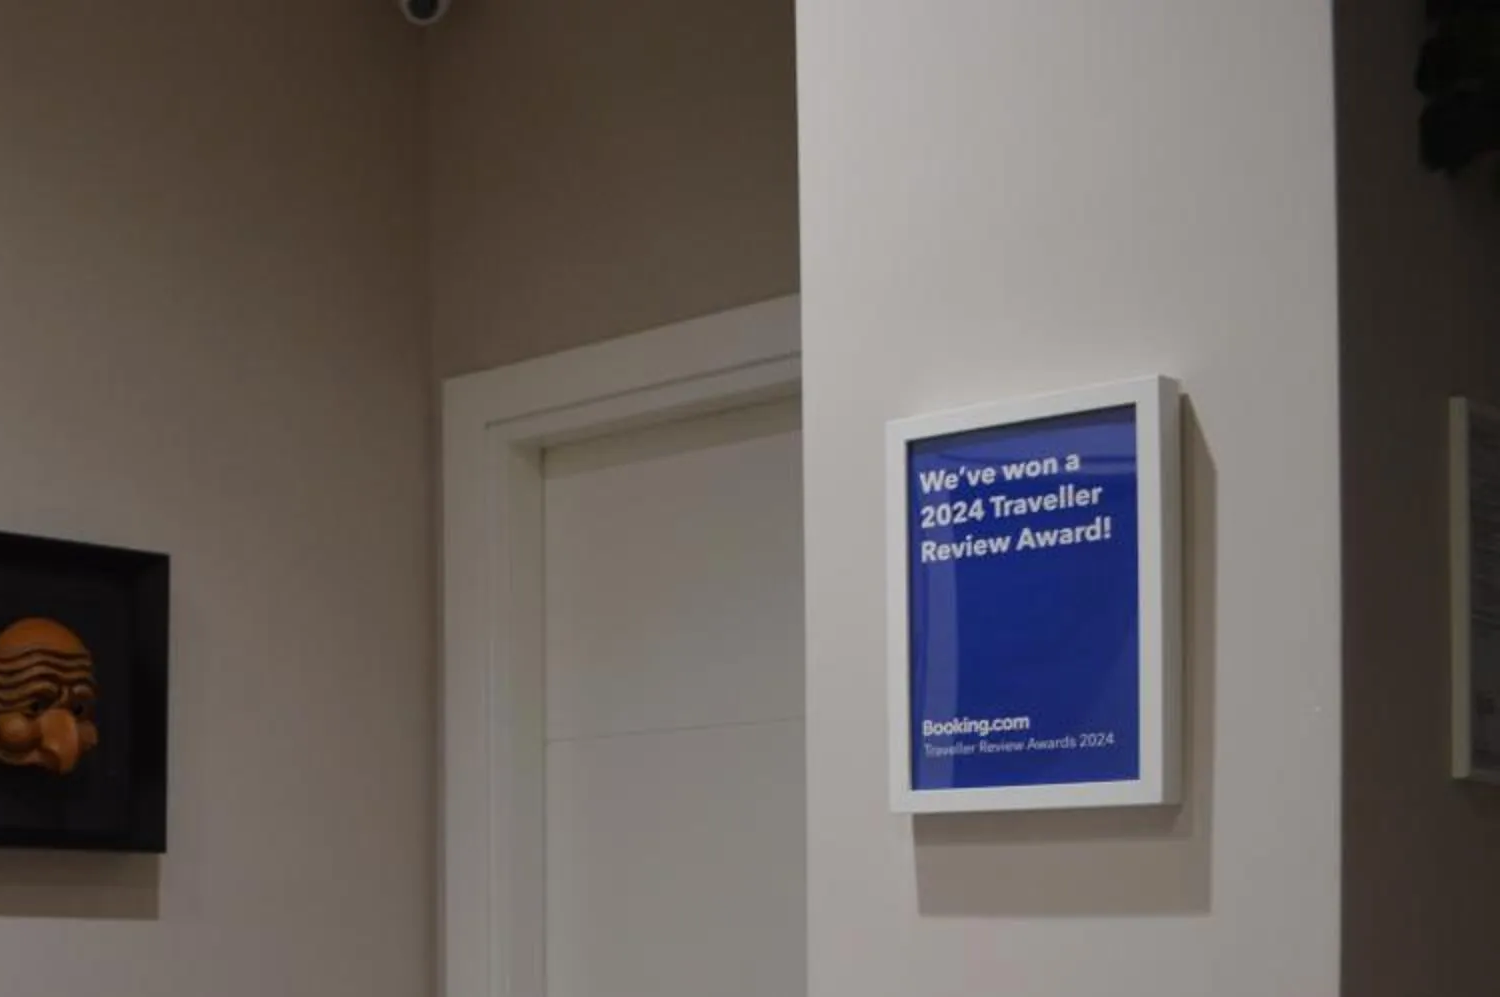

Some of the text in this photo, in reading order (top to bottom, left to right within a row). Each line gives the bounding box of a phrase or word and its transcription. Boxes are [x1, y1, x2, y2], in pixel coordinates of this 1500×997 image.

[919, 453, 1081, 494] We've won a
[921, 484, 1103, 528] 2024 Traveller
[921, 516, 1112, 563] Review Award!
[923, 716, 1030, 736] Booking.com
[924, 731, 1115, 757] Traveller Review Awards 2024
